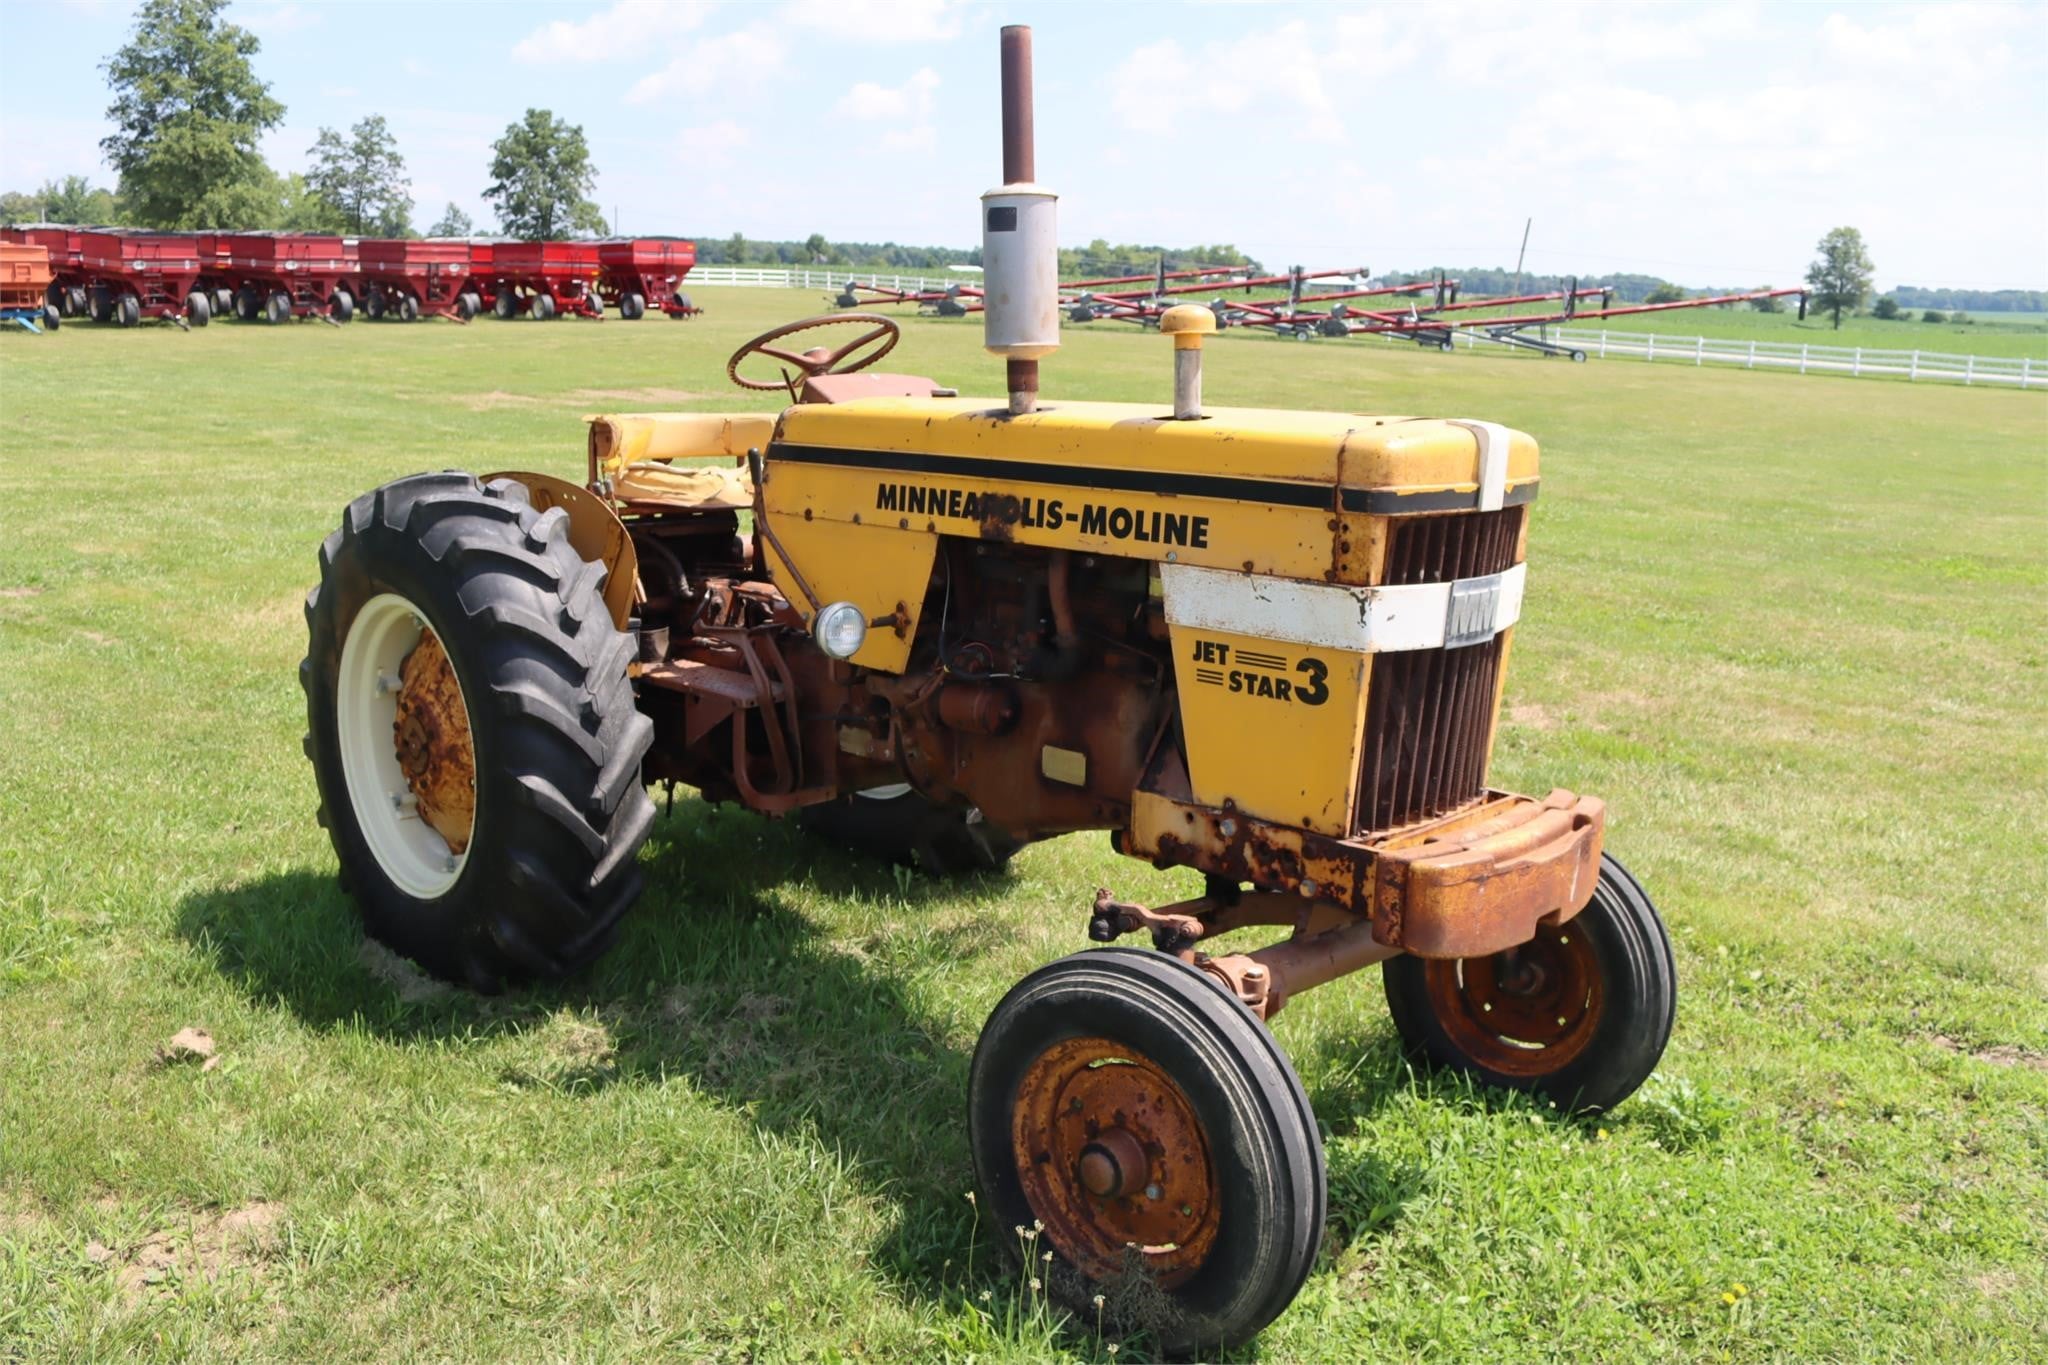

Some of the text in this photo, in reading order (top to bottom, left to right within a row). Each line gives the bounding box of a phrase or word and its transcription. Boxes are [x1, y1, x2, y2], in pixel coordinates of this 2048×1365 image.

[1192, 640, 1230, 666] JET
[1228, 658, 1330, 706] STAR 3
